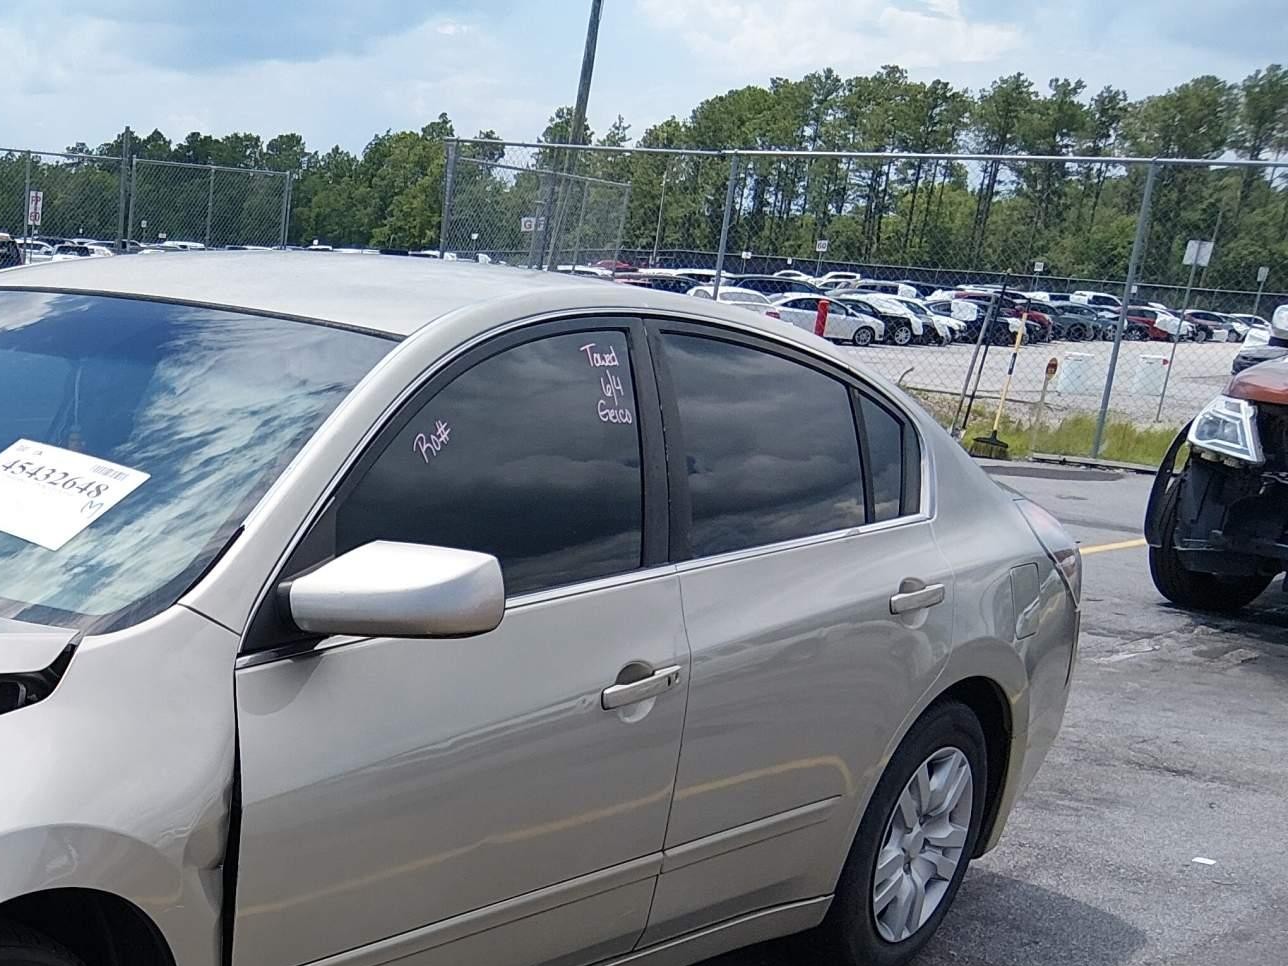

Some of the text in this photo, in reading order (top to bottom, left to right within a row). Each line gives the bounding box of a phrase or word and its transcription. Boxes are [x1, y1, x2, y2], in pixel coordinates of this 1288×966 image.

[579, 342, 619, 368] Towed
[600, 369, 625, 406] 6/4
[597, 400, 633, 425] Geico
[1, 458, 110, 499] 45432648
